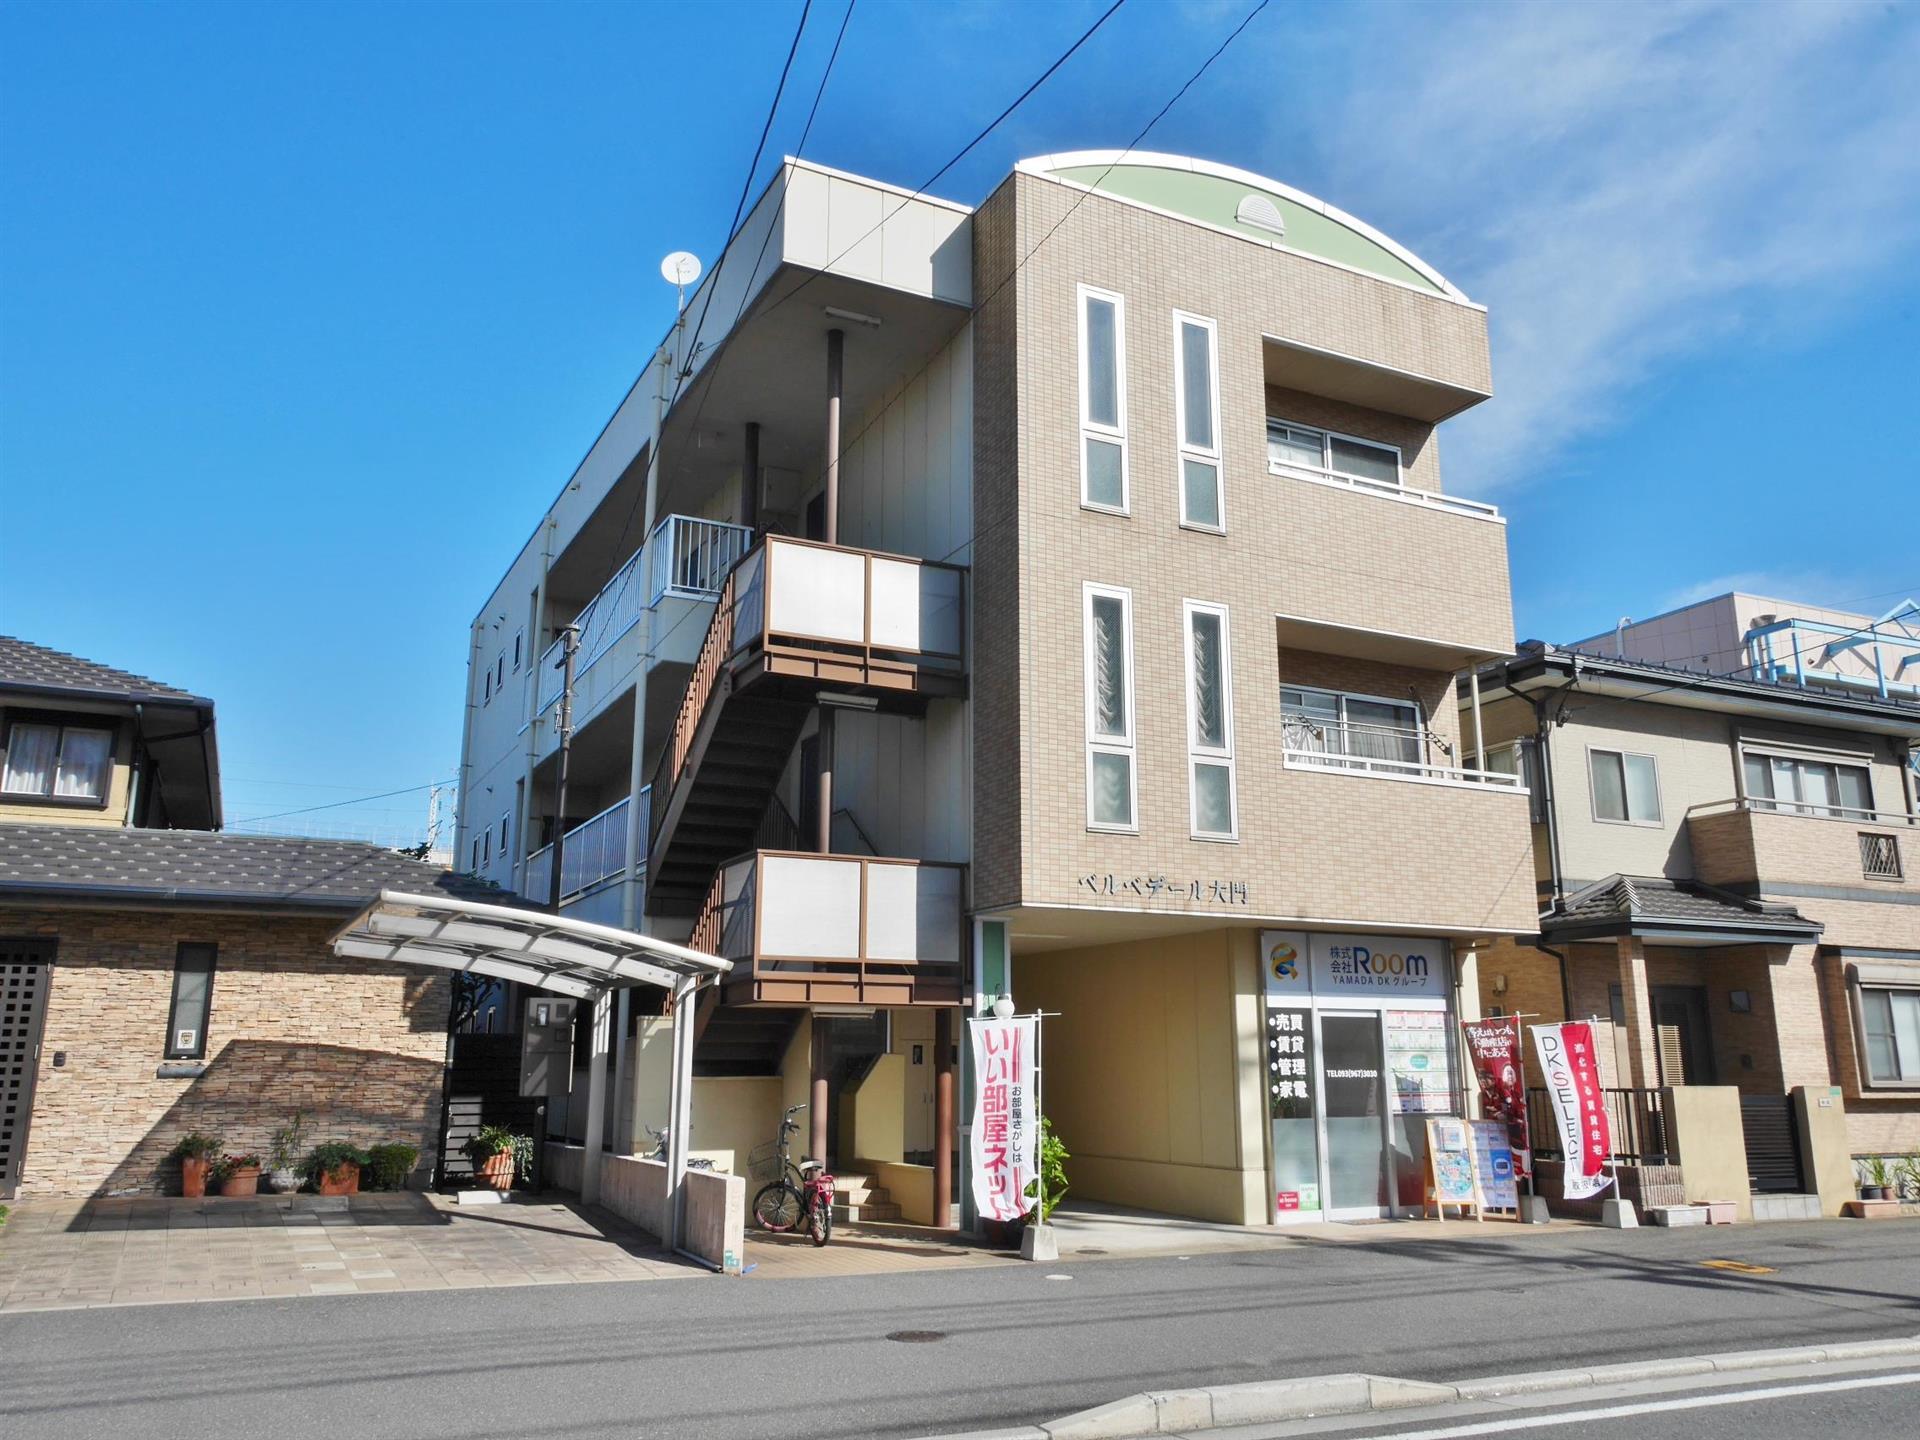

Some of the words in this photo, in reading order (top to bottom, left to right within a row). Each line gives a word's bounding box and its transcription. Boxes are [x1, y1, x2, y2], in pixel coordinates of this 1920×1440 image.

[1330, 945, 1352, 959] 株式
[1330, 960, 1352, 974] 会社
[1333, 975, 1374, 985] YAMADA
[1276, 1013, 1304, 1031] 売買
[1278, 1035, 1305, 1053] 賃貸
[1278, 1058, 1306, 1076] 管理
[1279, 1080, 1308, 1099] 家電
[983, 1028, 1008, 1220] いい部屋ネット
[1012, 1086, 1022, 1163] お部屋さがしは
